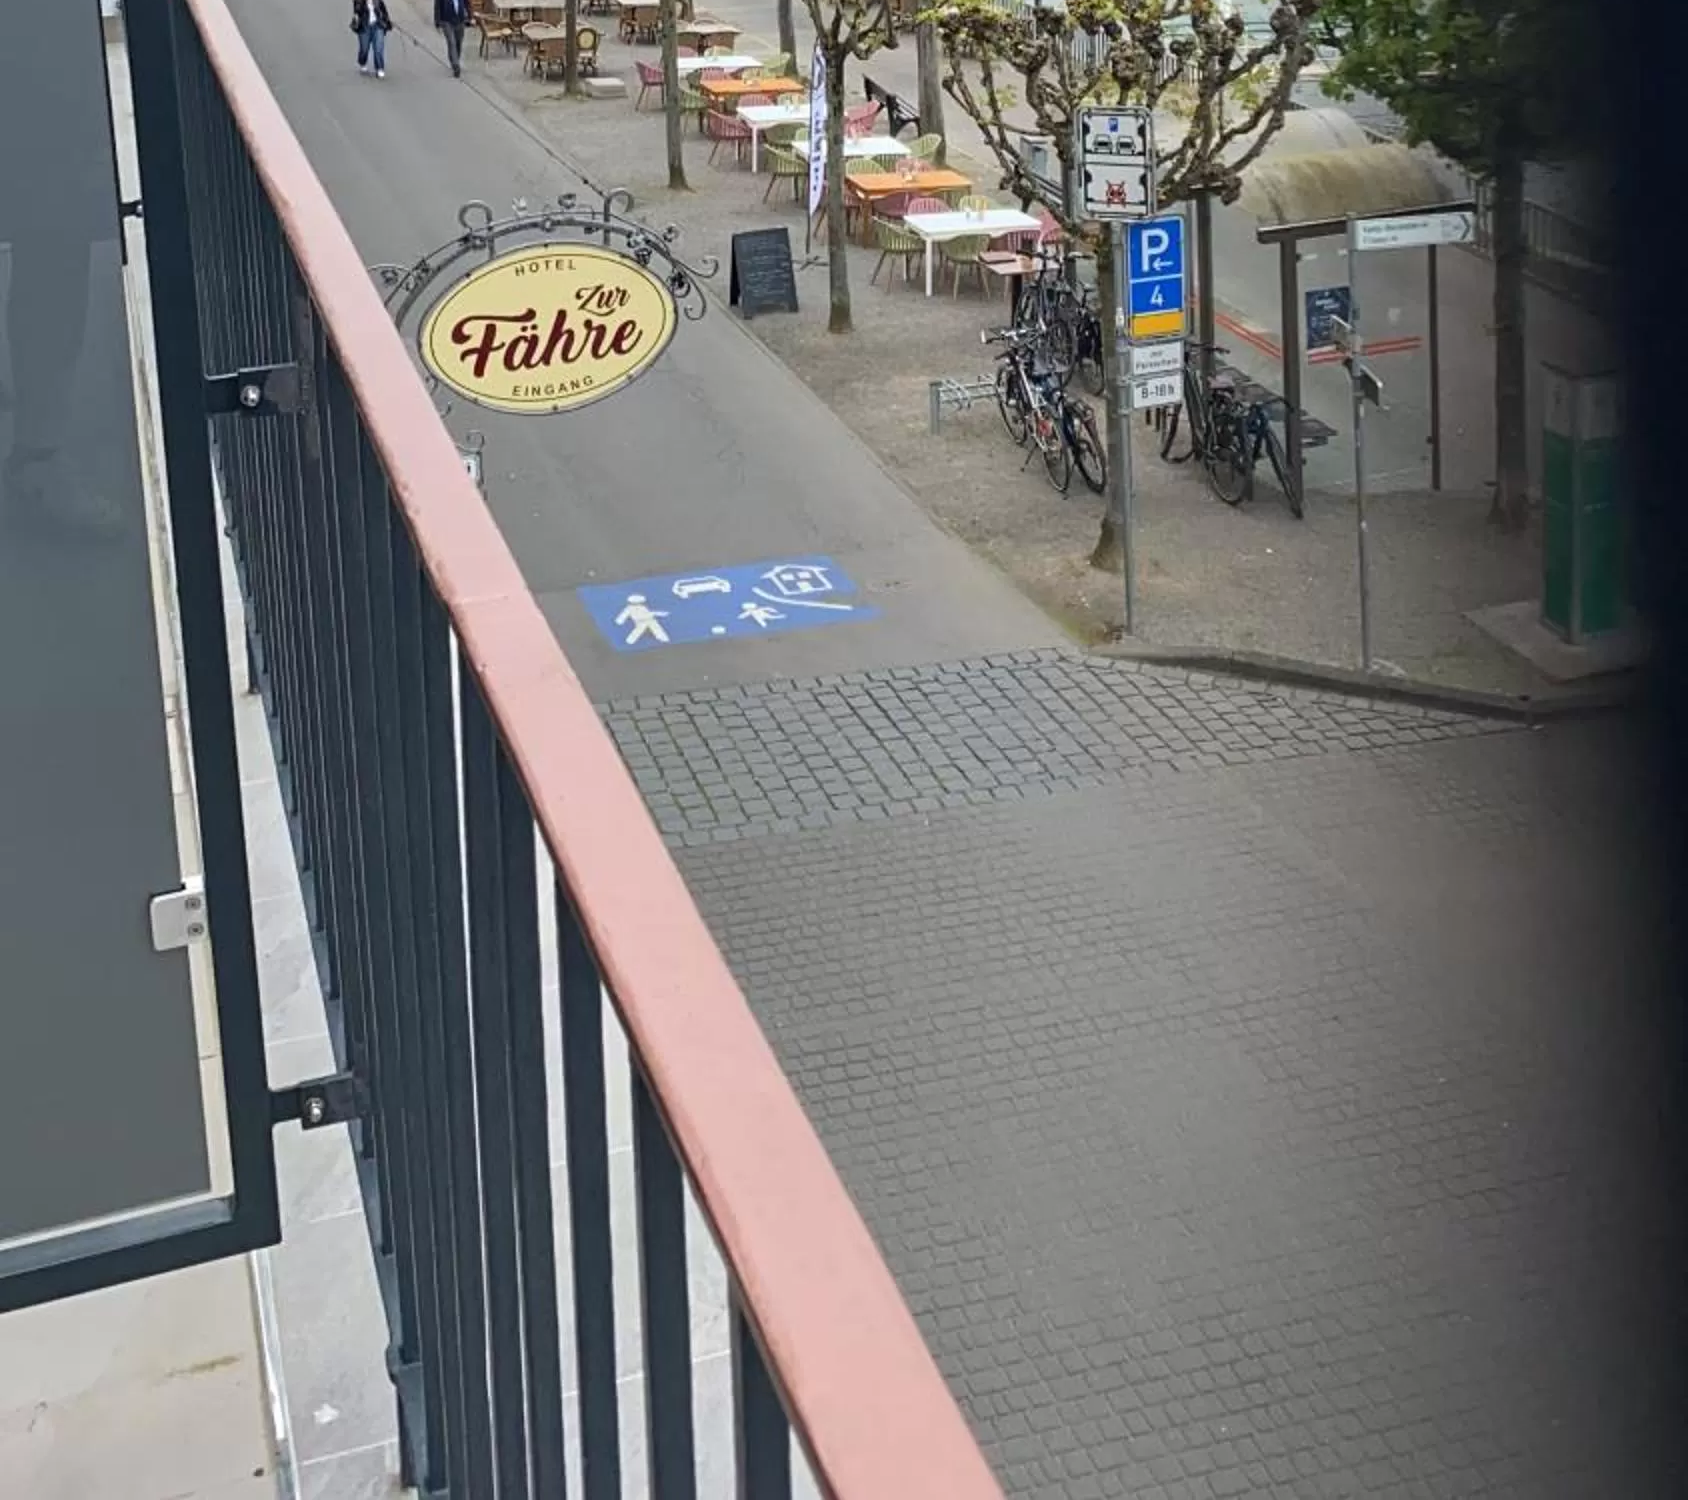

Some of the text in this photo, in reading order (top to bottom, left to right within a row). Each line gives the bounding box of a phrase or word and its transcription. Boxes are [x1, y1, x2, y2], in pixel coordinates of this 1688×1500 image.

[1141, 228, 1169, 272] P
[515, 259, 577, 277] HOTEL
[575, 284, 630, 316] Zur
[1150, 284, 1164, 306] 4
[451, 308, 643, 378] Fähre
[512, 375, 593, 397] EINGANG
